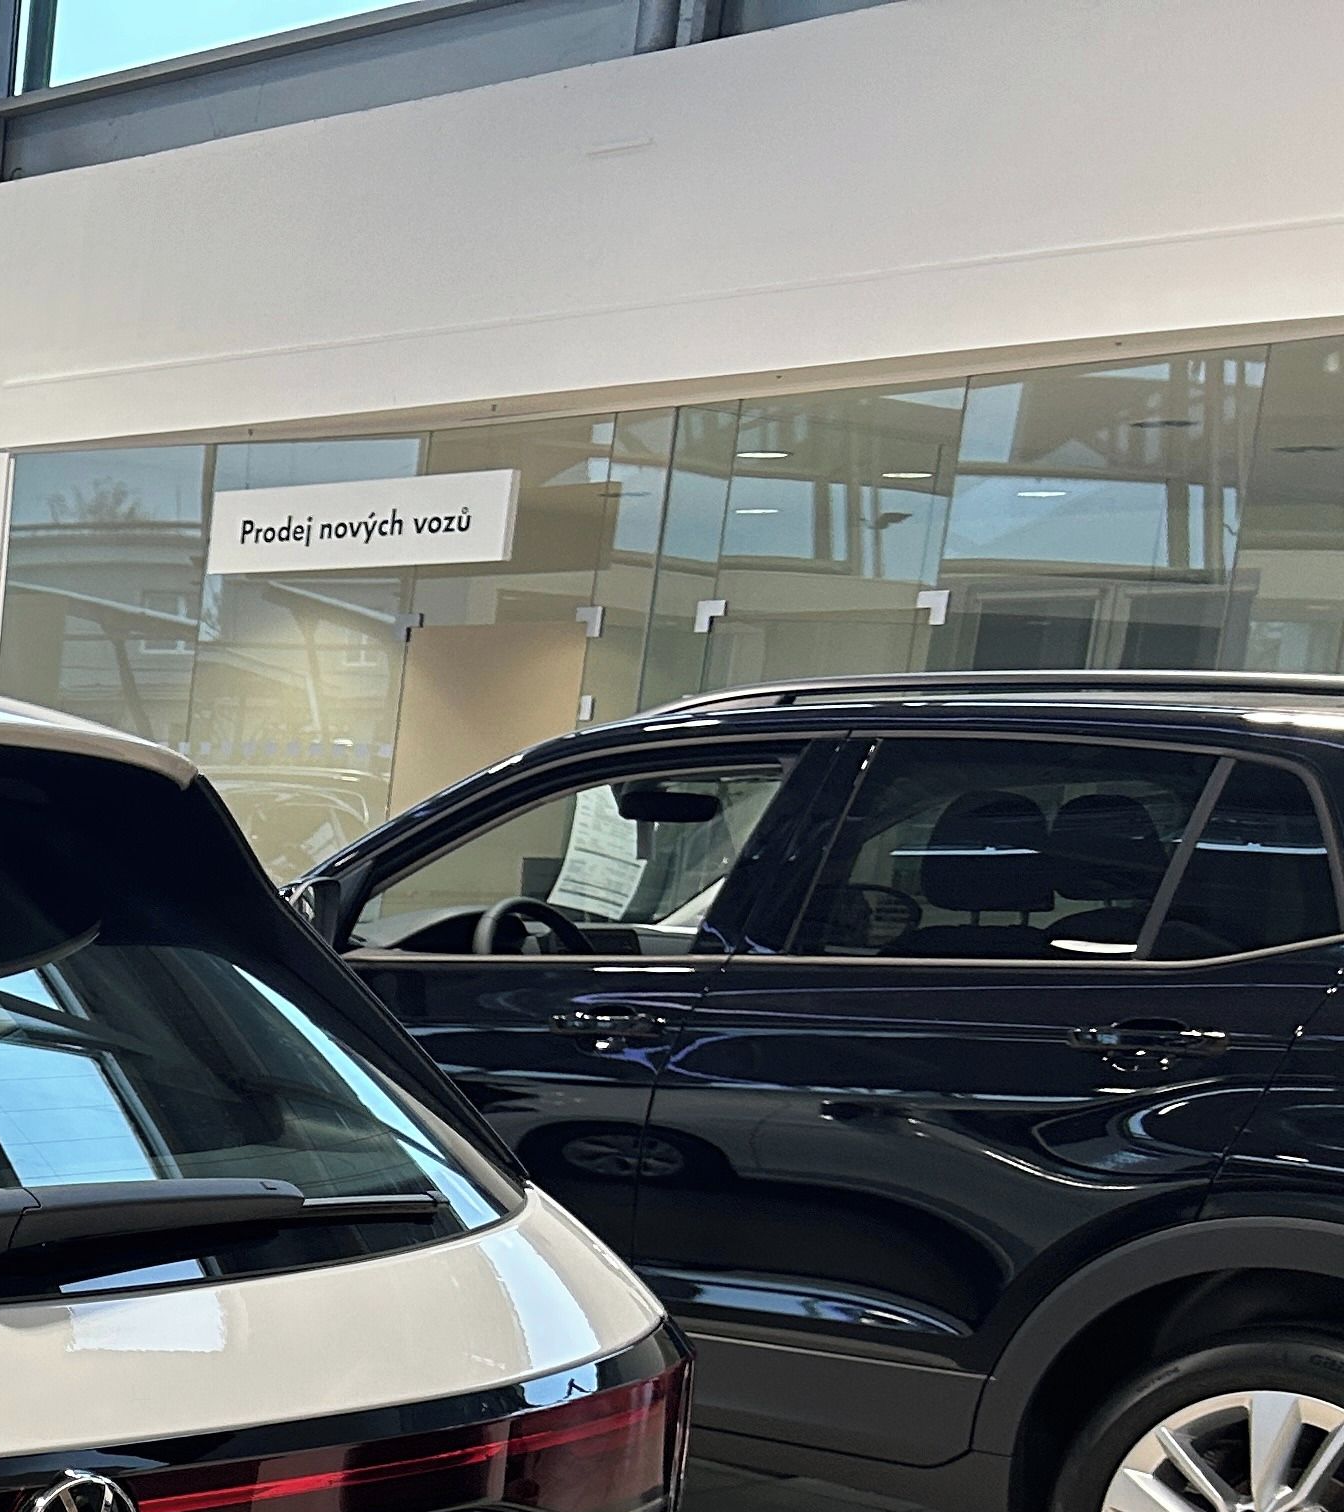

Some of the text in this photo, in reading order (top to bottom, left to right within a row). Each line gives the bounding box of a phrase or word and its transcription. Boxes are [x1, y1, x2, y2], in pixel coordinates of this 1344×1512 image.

[240, 506, 472, 547] Prodej nových vozů
